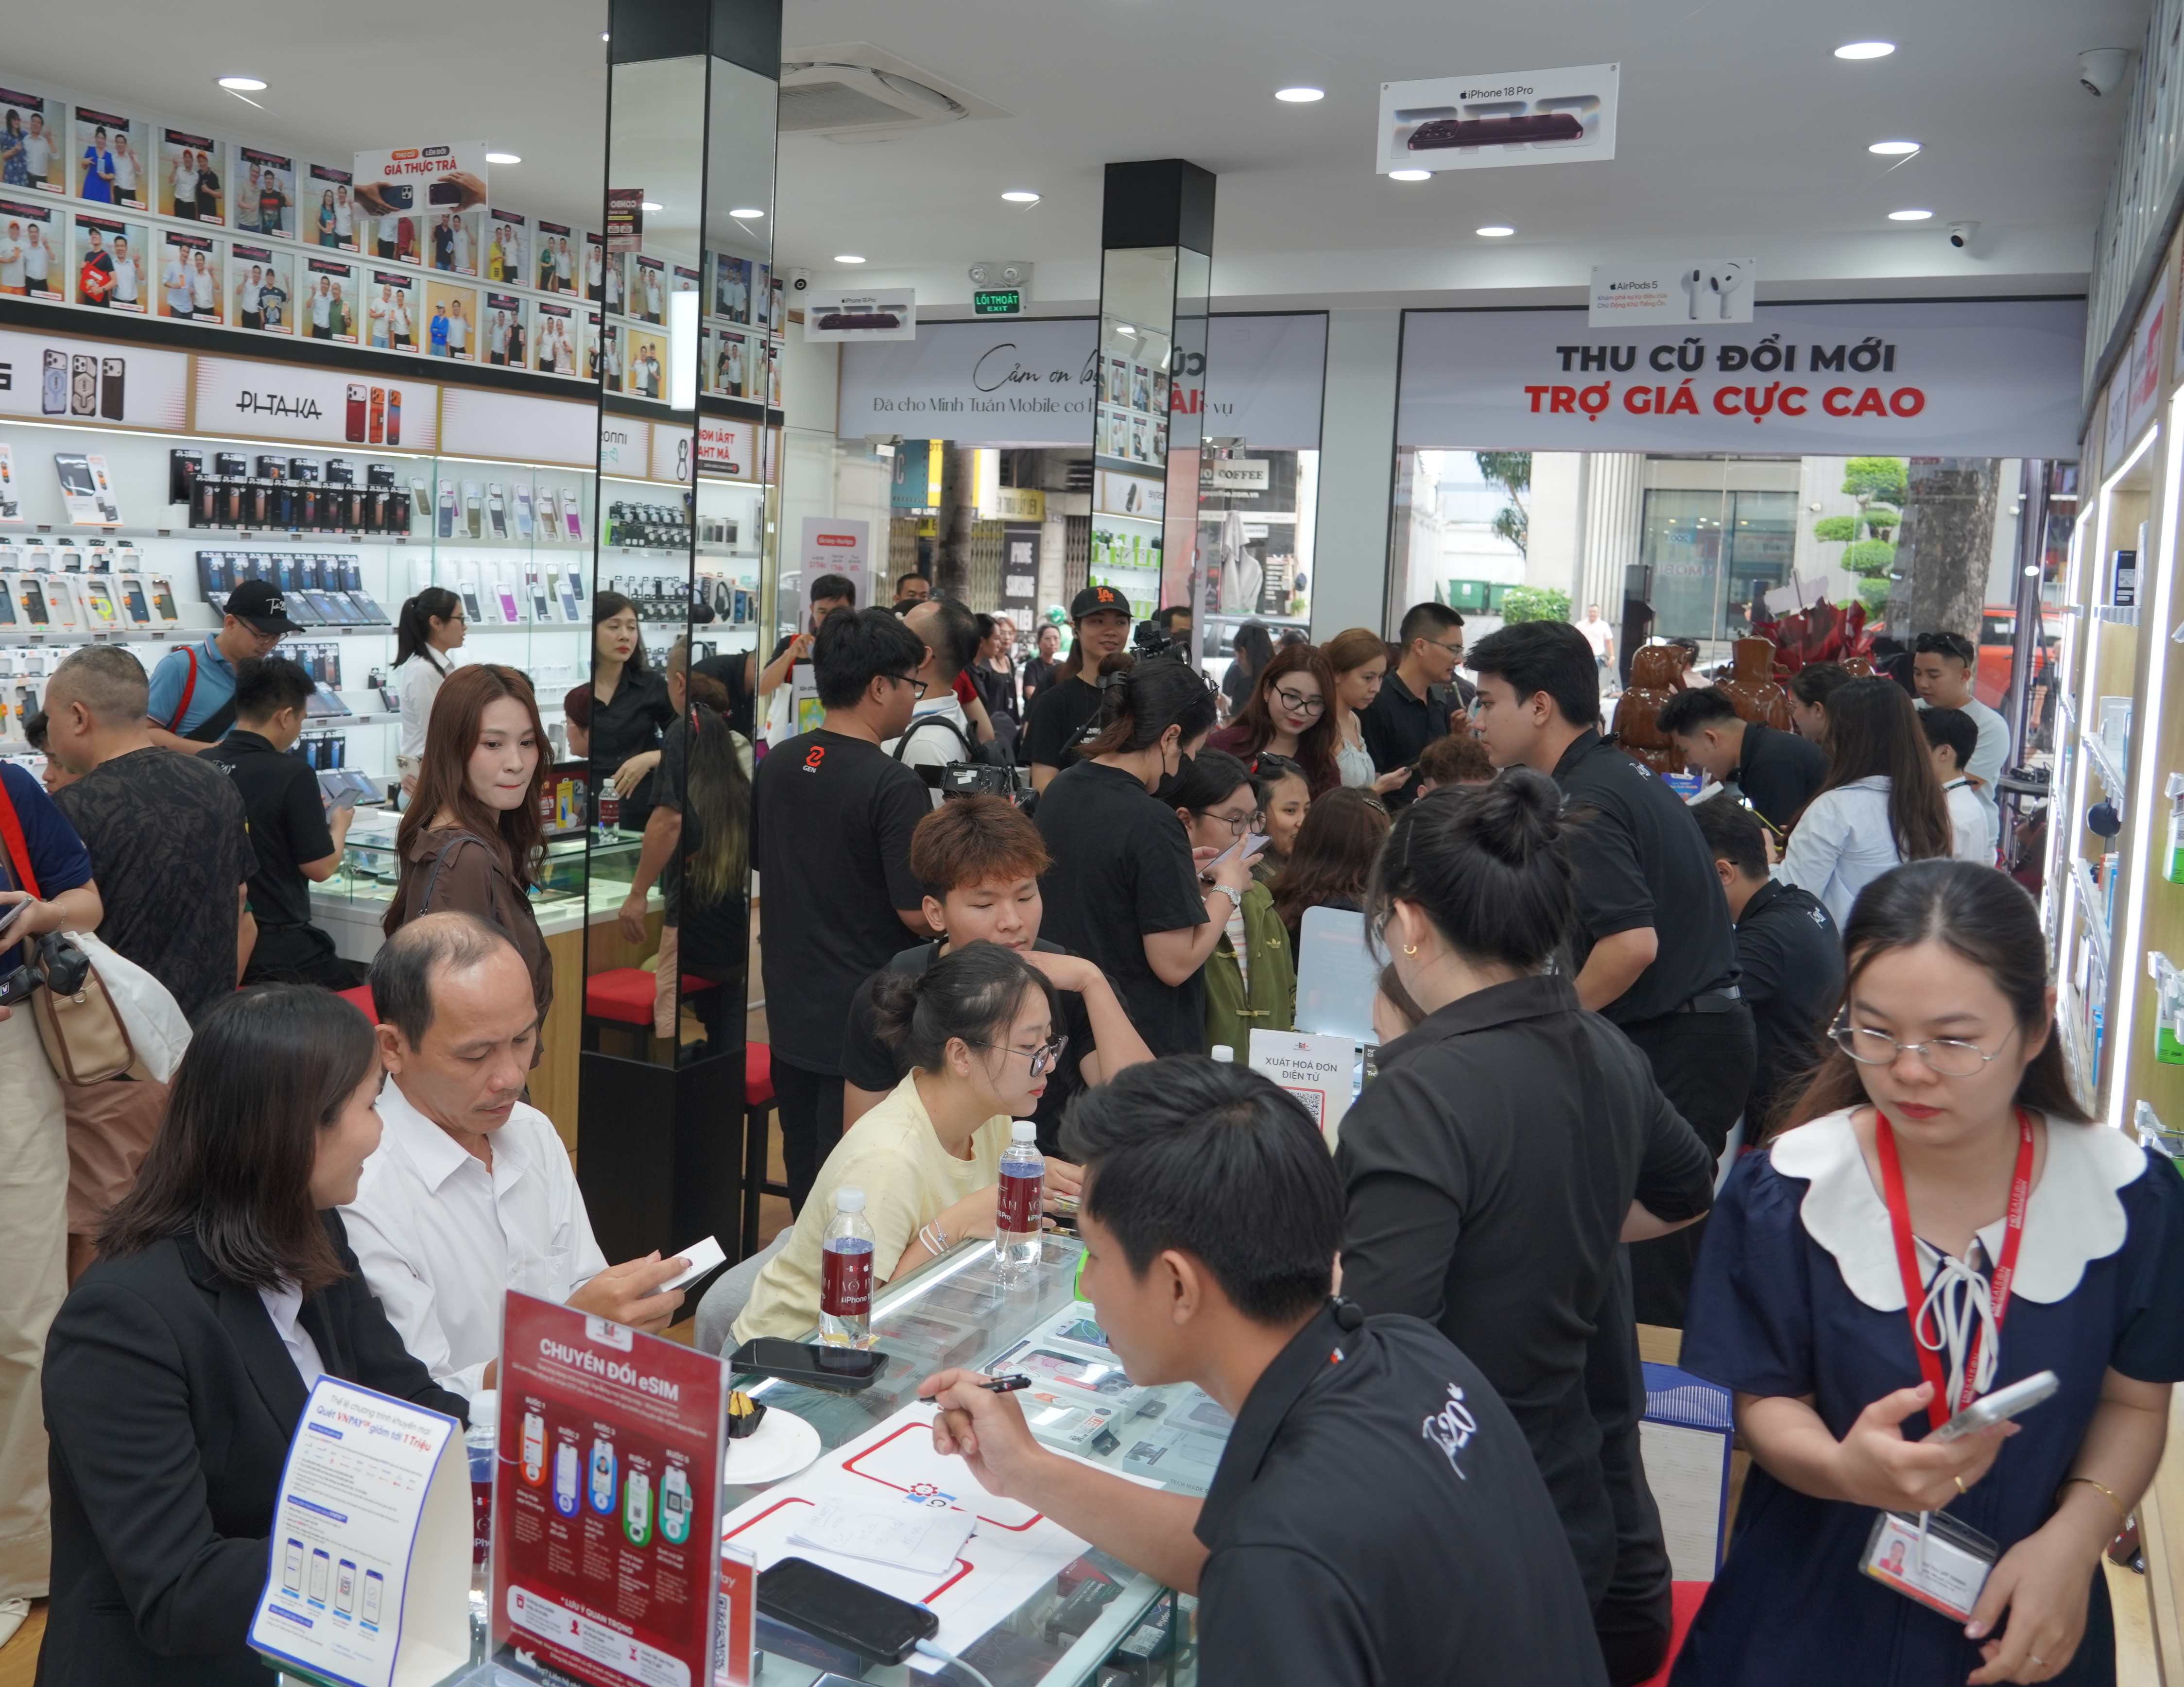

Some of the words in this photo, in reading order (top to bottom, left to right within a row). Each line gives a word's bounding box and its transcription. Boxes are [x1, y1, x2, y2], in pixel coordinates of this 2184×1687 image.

[1468, 88, 1502, 99] iPhone
[1504, 87, 1514, 96] 18
[1516, 86, 1533, 95] Pro
[384, 161, 403, 175] GIÁ
[405, 160, 433, 175] THỰC
[435, 156, 457, 170] TRẢ
[1617, 281, 1651, 290] AirPods
[976, 294, 989, 305] LỐI
[990, 293, 1018, 304] THOÁT
[1557, 345, 1636, 371] THU
[1649, 338, 1705, 372] CŨ
[1716, 333, 1797, 372] ĐỔI
[1809, 337, 1896, 372] MỚI
[973, 343, 1043, 392] Cảm
[235, 390, 323, 421] PITAKA
[874, 397, 894, 412] Đã
[898, 397, 925, 412] cho
[929, 397, 963, 412] Minh
[969, 396, 1005, 412] Tuấn
[1010, 397, 1059, 413] Mobile
[1525, 380, 1613, 422] TRỢ
[1623, 378, 1700, 416] GIÁ
[1713, 381, 1809, 425] CỰC
[1822, 386, 1926, 418] CAO
[1213, 403, 1233, 417] vụ
[1219, 469, 1264, 480] COFFEE
[1096, 586, 1114, 603] LA
[802, 765, 817, 774] GEN
[1265, 1056, 1290, 1067] XUẤT
[1292, 1060, 1313, 1069] HOÁ
[1316, 1062, 1338, 1072] ĐƠN
[1282, 1069, 1304, 1081] ĐIỆN
[1306, 1072, 1321, 1082] TỬ
[844, 1295, 867, 1304] iPhone
[540, 1338, 605, 1376] CHUYỂN
[606, 1361, 637, 1386] ĐỔI
[638, 1376, 679, 1402] eSIM
[330, 1395, 342, 1405] Thể
[343, 1400, 350, 1408] lệ
[350, 1403, 376, 1418] chương
[376, 1412, 392, 1423] trình
[392, 1416, 417, 1431] khuyến
[418, 1426, 432, 1436] mại
[316, 1405, 336, 1419] Quét
[369, 1424, 390, 1437] giảm
[391, 1430, 402, 1441] tới
[403, 1434, 409, 1443] 1
[409, 1435, 432, 1452] Triệu
[575, 1432, 580, 1441] 2
[1170, 1479, 1185, 1487] TECH
[1186, 1482, 1204, 1492] MADE
[565, 1598, 580, 1612] LƯU
[585, 1607, 608, 1625] QUAN
[607, 1617, 634, 1635] TRỌNG
